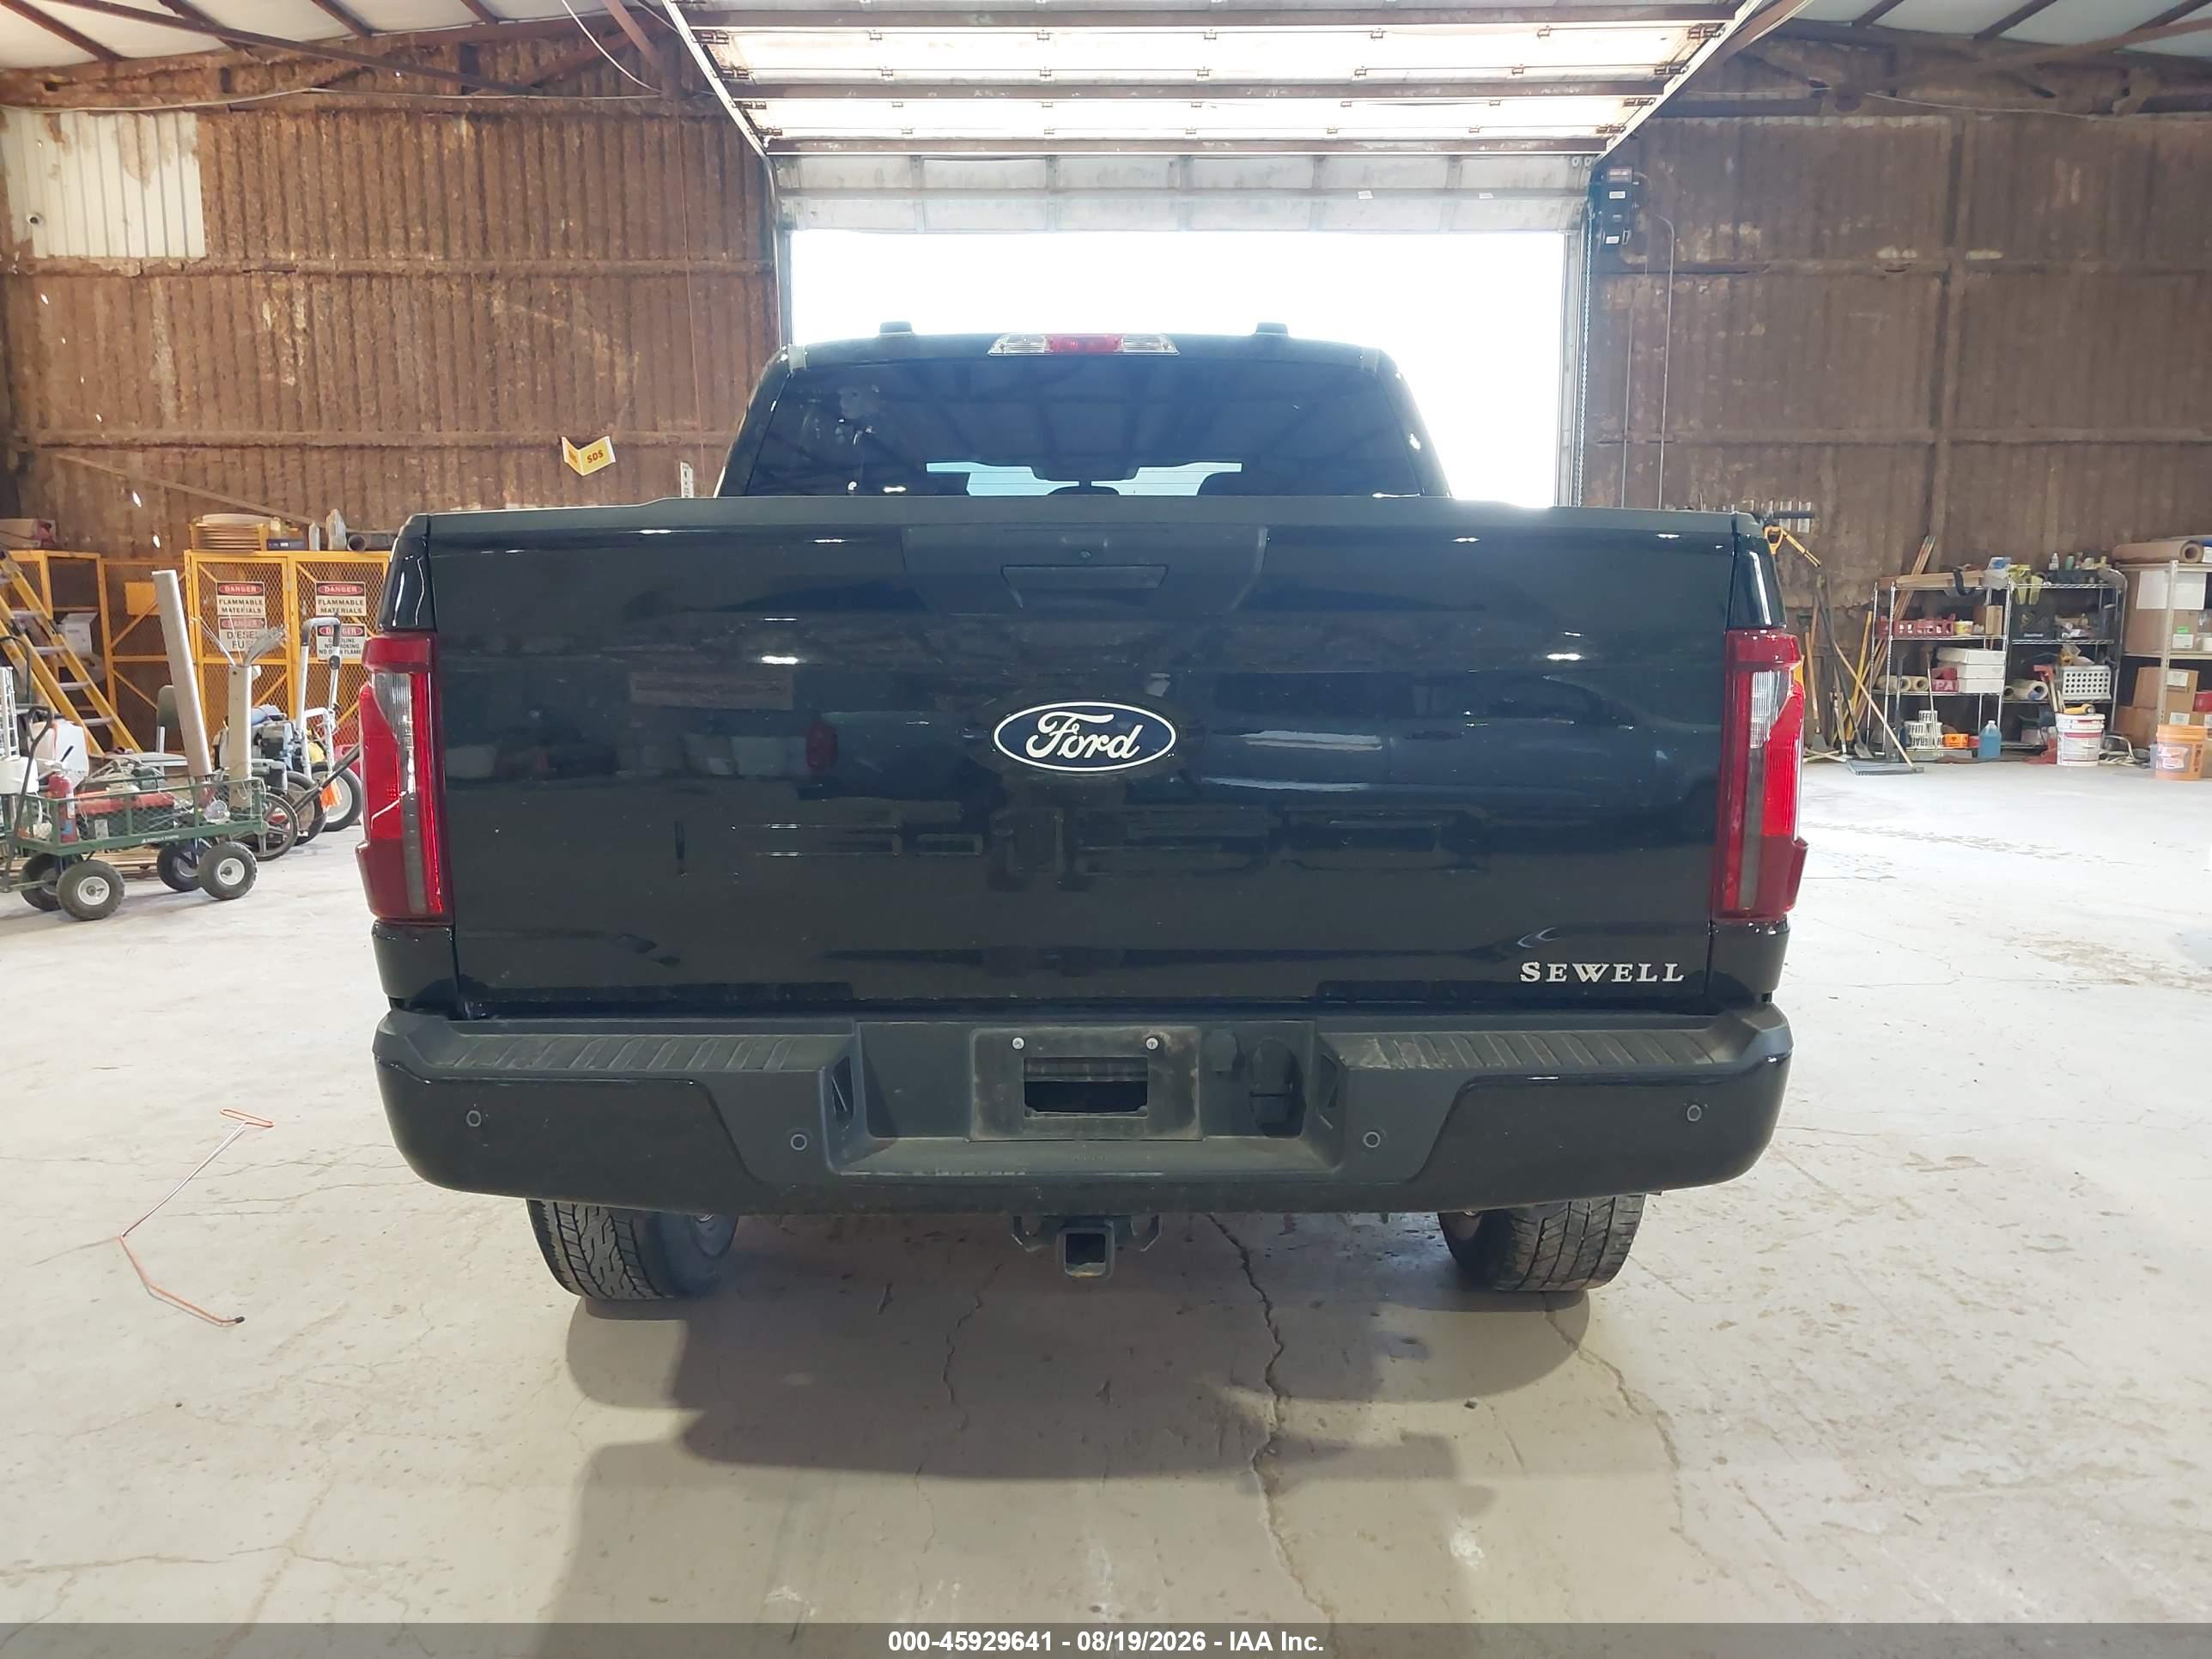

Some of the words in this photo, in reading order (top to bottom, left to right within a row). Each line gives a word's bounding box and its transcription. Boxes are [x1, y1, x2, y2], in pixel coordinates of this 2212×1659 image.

[586, 449, 604, 464] SDS
[1025, 711, 1144, 759] Ford
[1519, 961, 1685, 982] SEWELL
